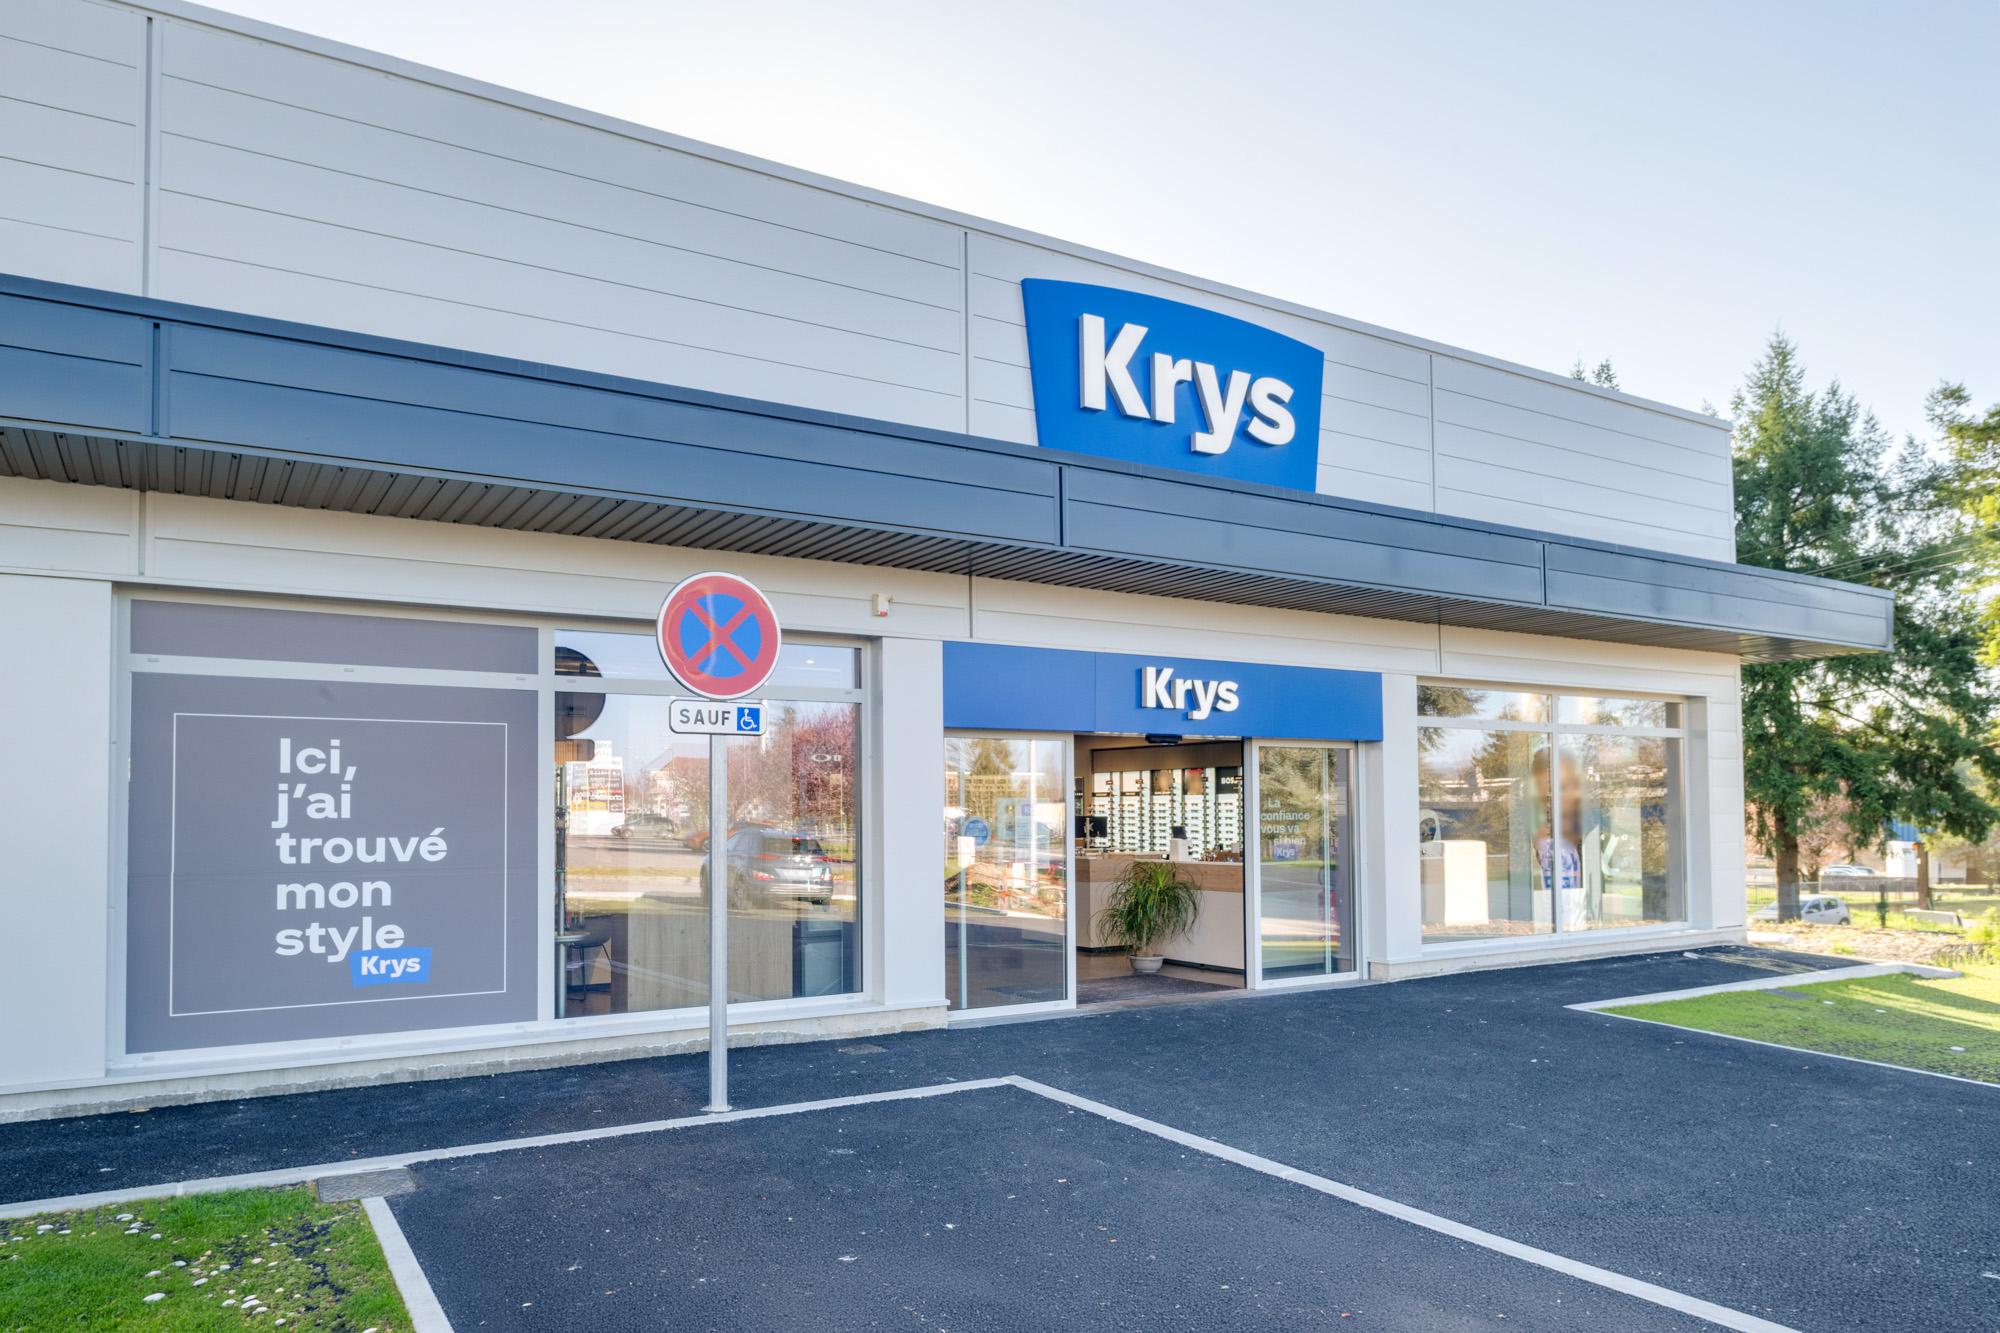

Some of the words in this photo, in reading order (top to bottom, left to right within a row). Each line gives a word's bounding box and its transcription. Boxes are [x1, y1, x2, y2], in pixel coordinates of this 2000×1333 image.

[1079, 312, 1297, 455] Krys
[1141, 665, 1240, 720] Krys
[679, 708, 731, 726] SAUF
[279, 737, 357, 781] Ici,
[1260, 809, 1310, 820] confiance
[1260, 824, 1286, 833] vous
[1287, 824, 1300, 833] va
[275, 827, 448, 865] trouvé
[276, 880, 392, 910] mon
[275, 916, 405, 963] style
[361, 955, 421, 978] Krys
